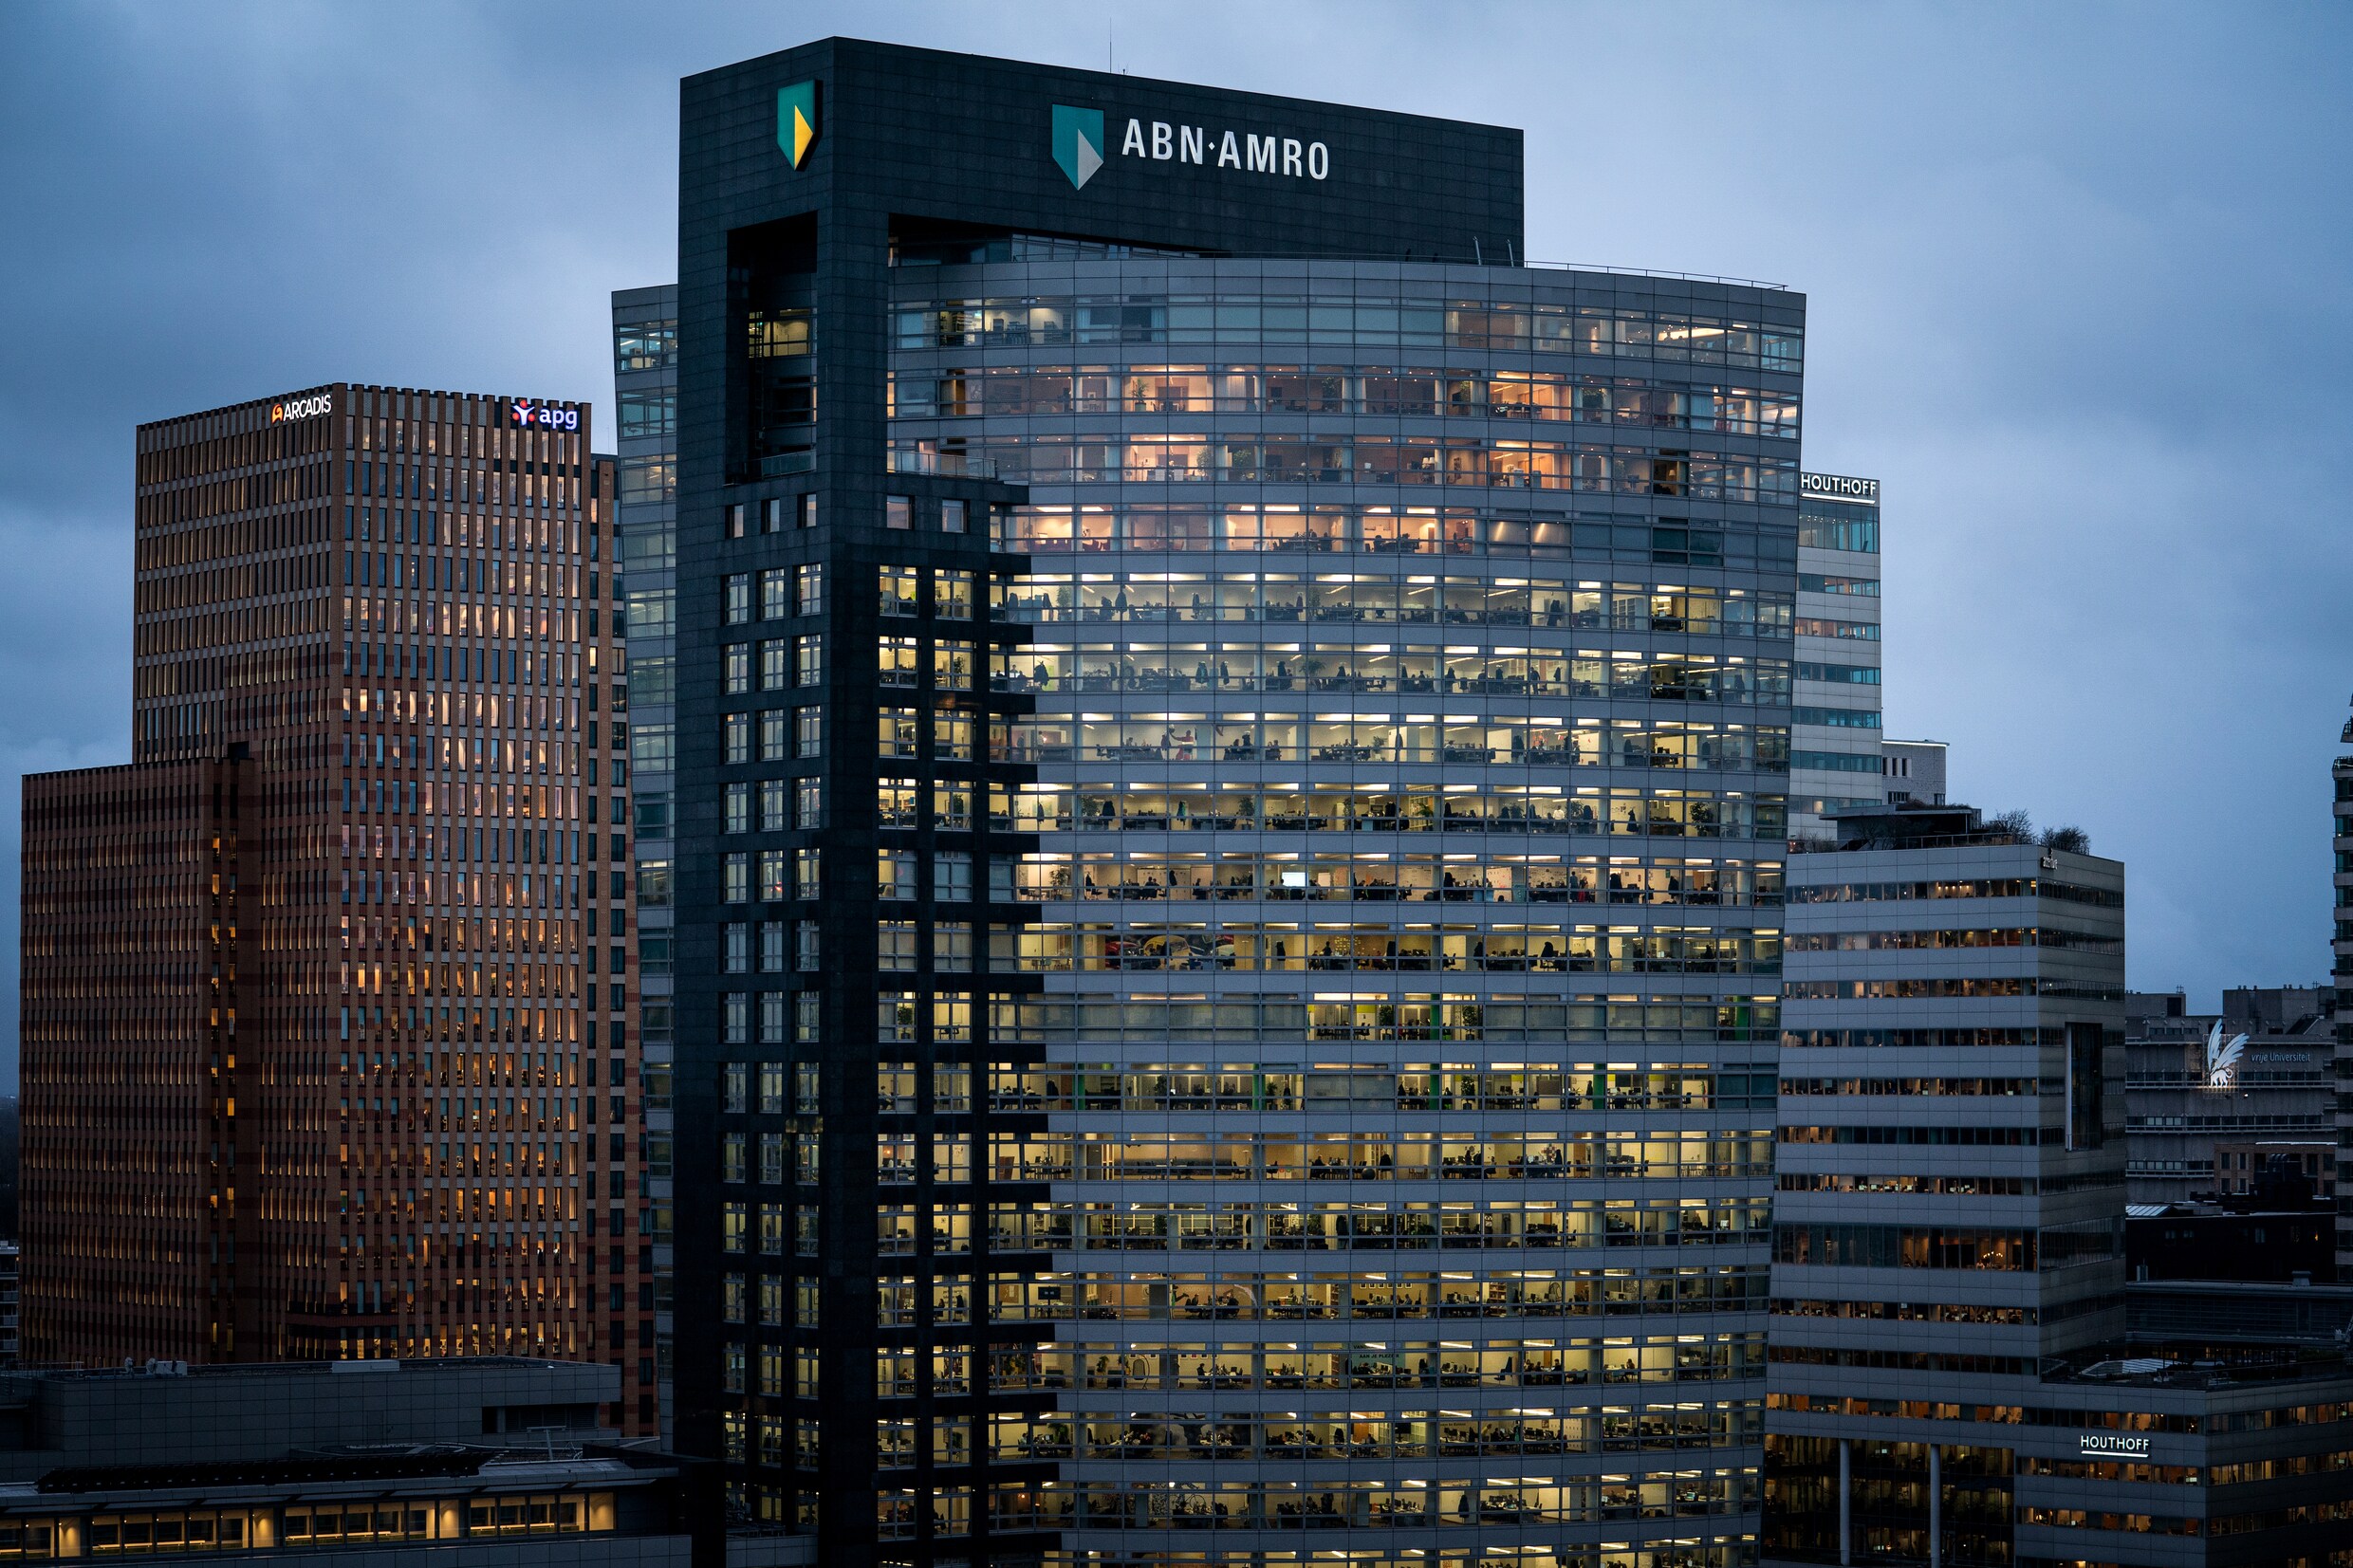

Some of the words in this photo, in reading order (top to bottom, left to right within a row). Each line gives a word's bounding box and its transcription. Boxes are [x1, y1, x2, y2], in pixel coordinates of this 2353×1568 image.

[283, 395, 332, 421] ARCADIS
[539, 408, 578, 430] apg
[1801, 473, 1877, 496] HOUTHOFF
[2251, 1053, 2268, 1063] vrije
[2270, 1051, 2311, 1062] Universiteit
[2081, 1435, 2150, 1450] HOUTHOFF
